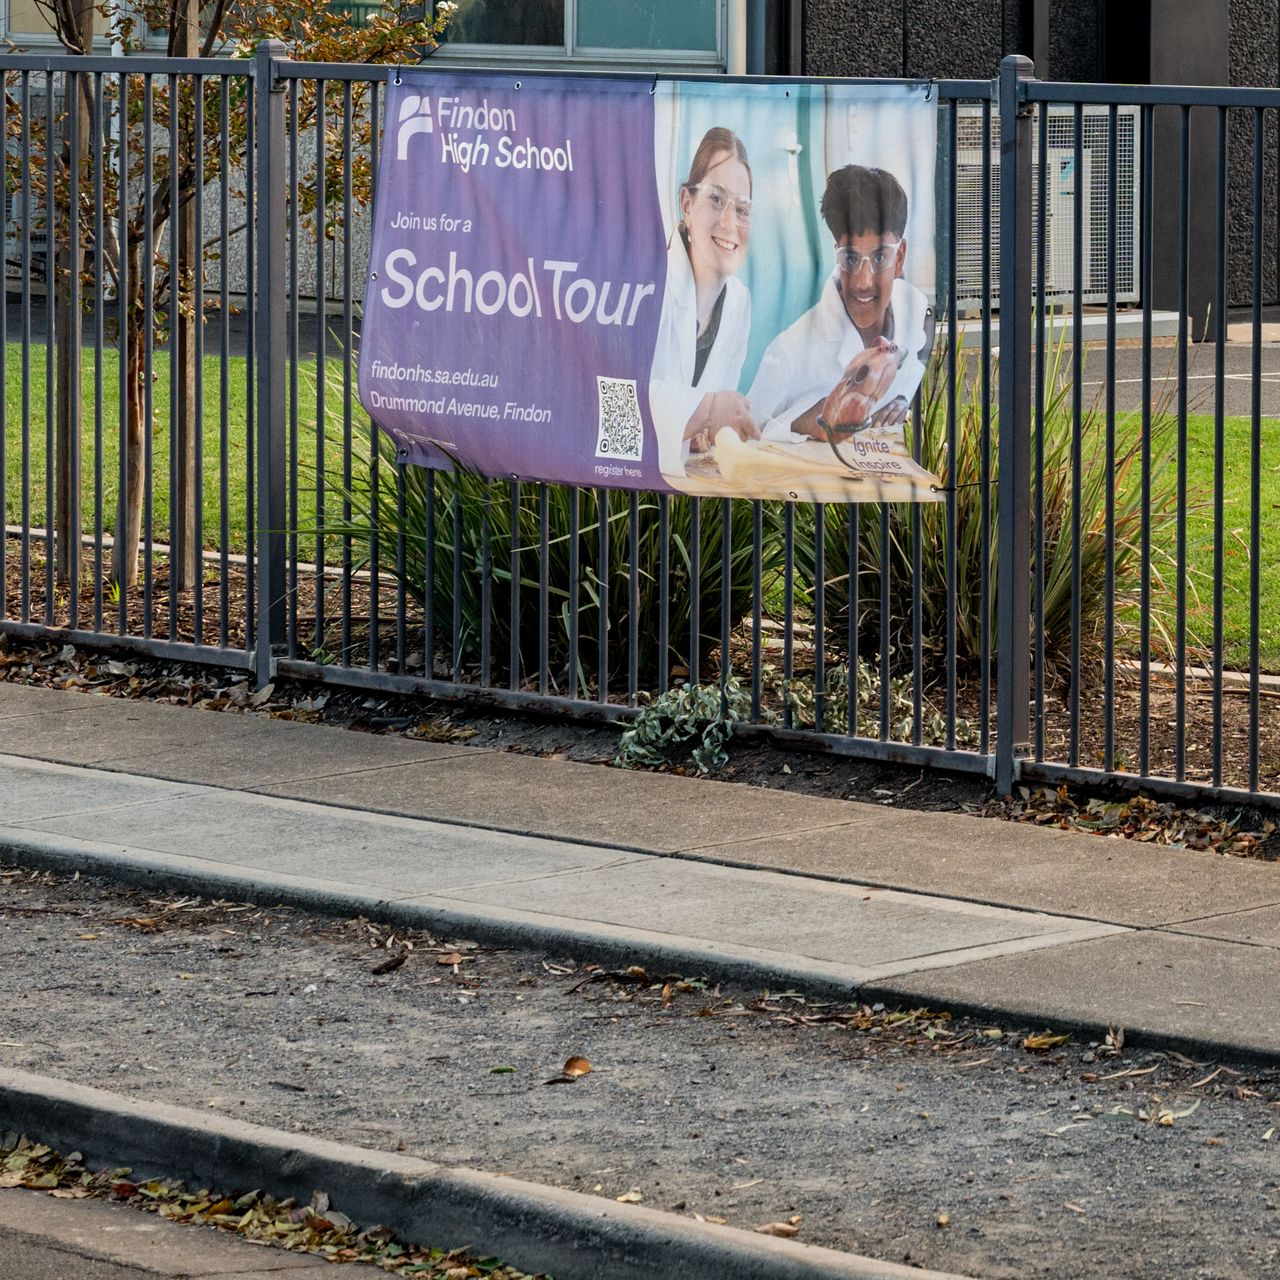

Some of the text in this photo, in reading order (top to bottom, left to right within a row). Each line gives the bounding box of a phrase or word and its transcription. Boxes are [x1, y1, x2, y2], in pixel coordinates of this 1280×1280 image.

[438, 97, 516, 131] Findon
[441, 133, 573, 173] High School
[391, 212, 472, 232] Join us for a
[381, 248, 655, 326] School Tour
[371, 360, 498, 388] findonhs.sa.edu.au
[371, 391, 551, 423] Drummond Avenue, Findon
[853, 437, 890, 456] Ignite
[595, 464, 642, 477] register here
[853, 458, 902, 470] Inspire
